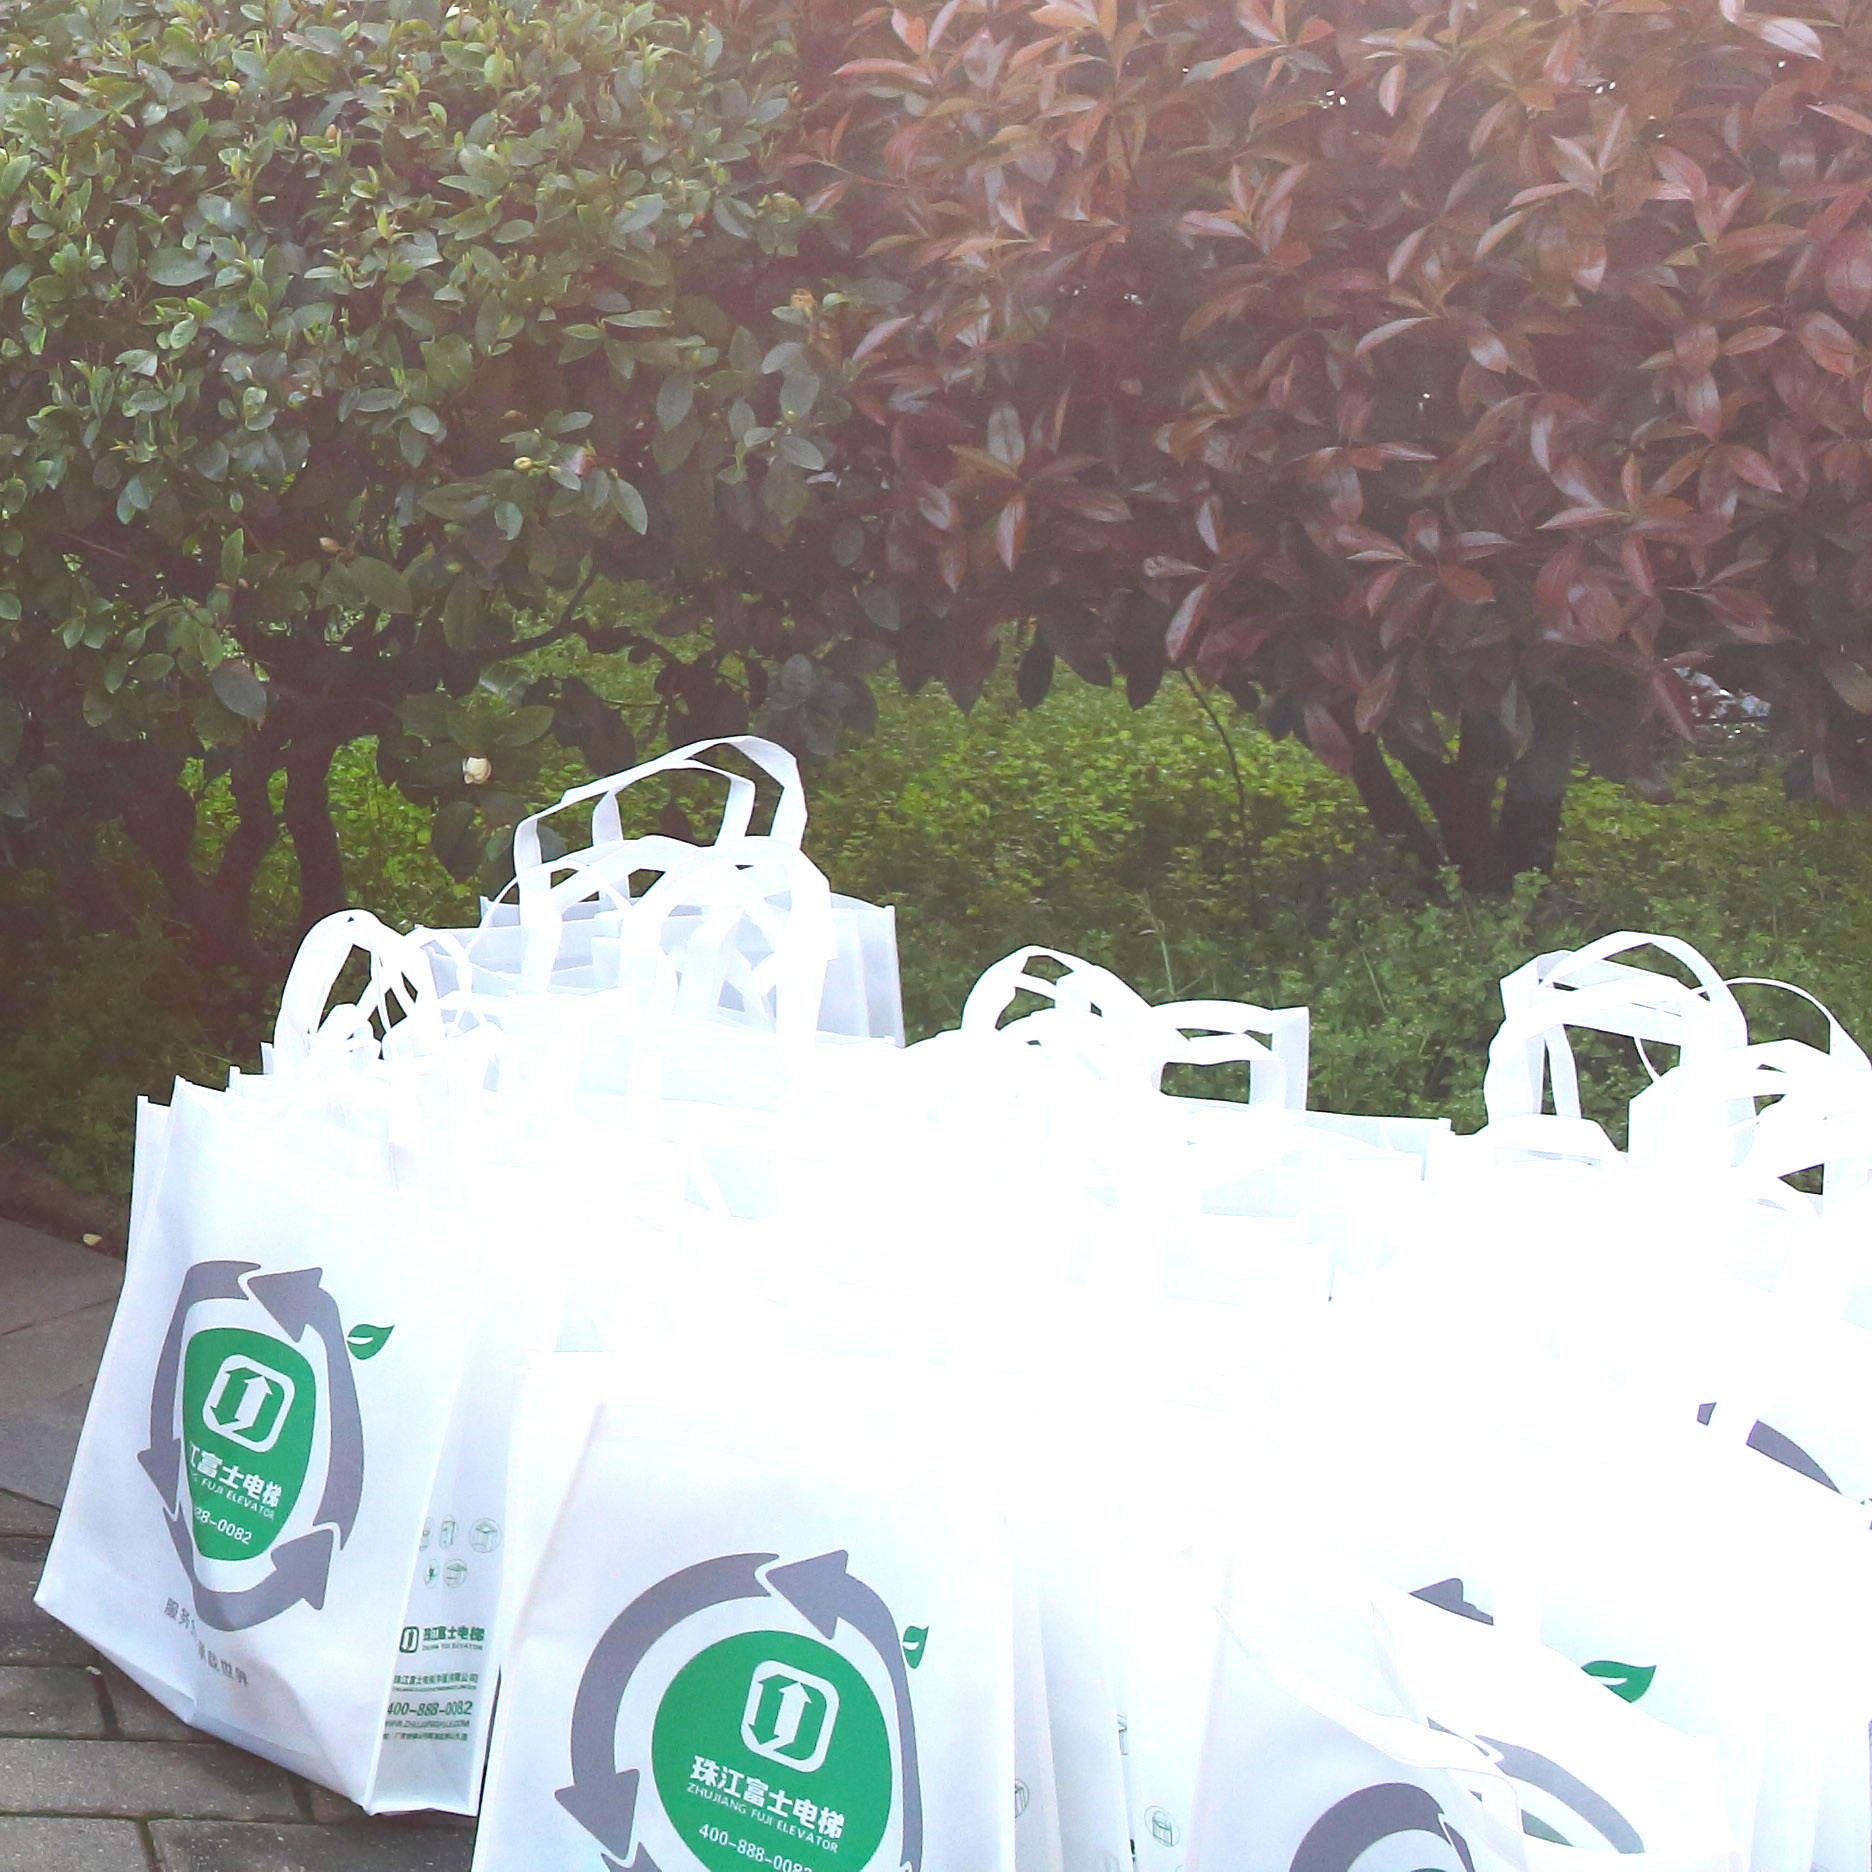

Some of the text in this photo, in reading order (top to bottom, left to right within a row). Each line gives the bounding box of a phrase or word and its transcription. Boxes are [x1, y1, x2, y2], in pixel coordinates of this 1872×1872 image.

[686, 1782, 840, 1853] ZHUJIANG FUJI ELEVATOR
[689, 1754, 846, 1840] 珠江富士电梯
